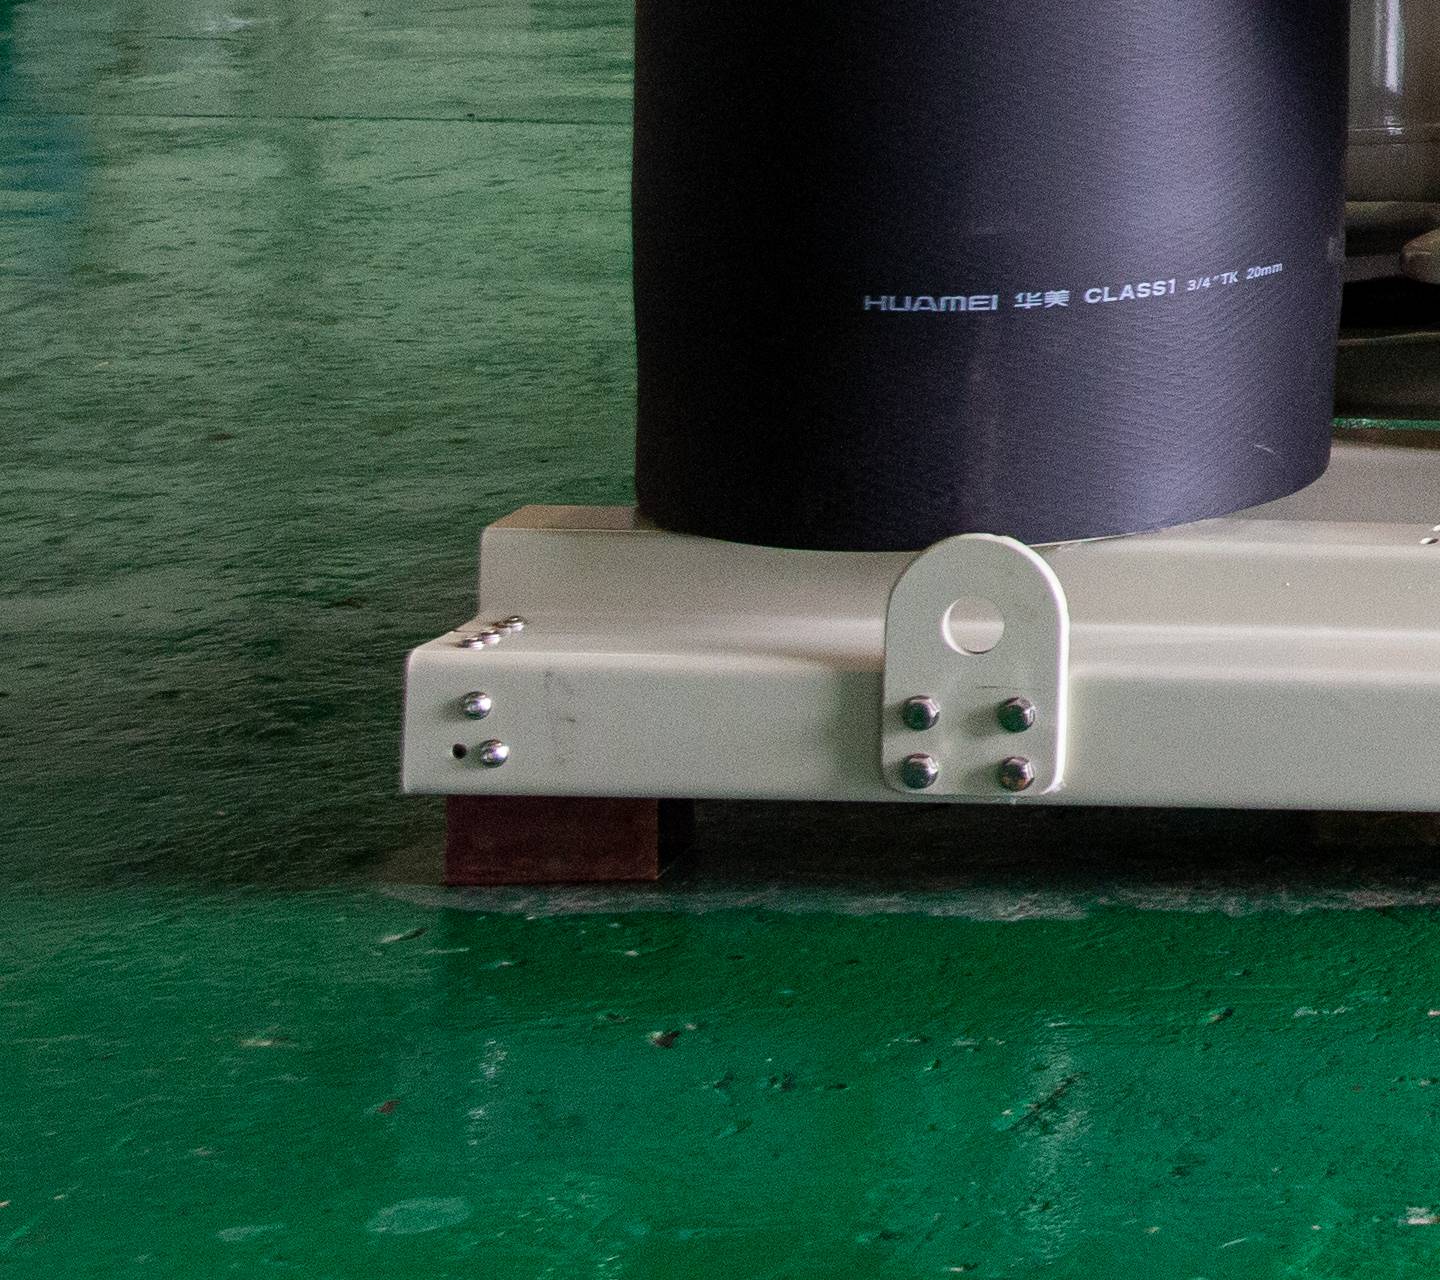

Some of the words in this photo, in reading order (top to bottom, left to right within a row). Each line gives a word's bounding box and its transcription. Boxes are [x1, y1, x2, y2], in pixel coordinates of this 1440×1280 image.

[864, 293, 998, 311] HUAMEI
[1014, 290, 1071, 309] 华美
[1085, 278, 1178, 305] CLASS1
[1187, 269, 1239, 293] 3/4"TK
[1246, 261, 1284, 281] 20mm
